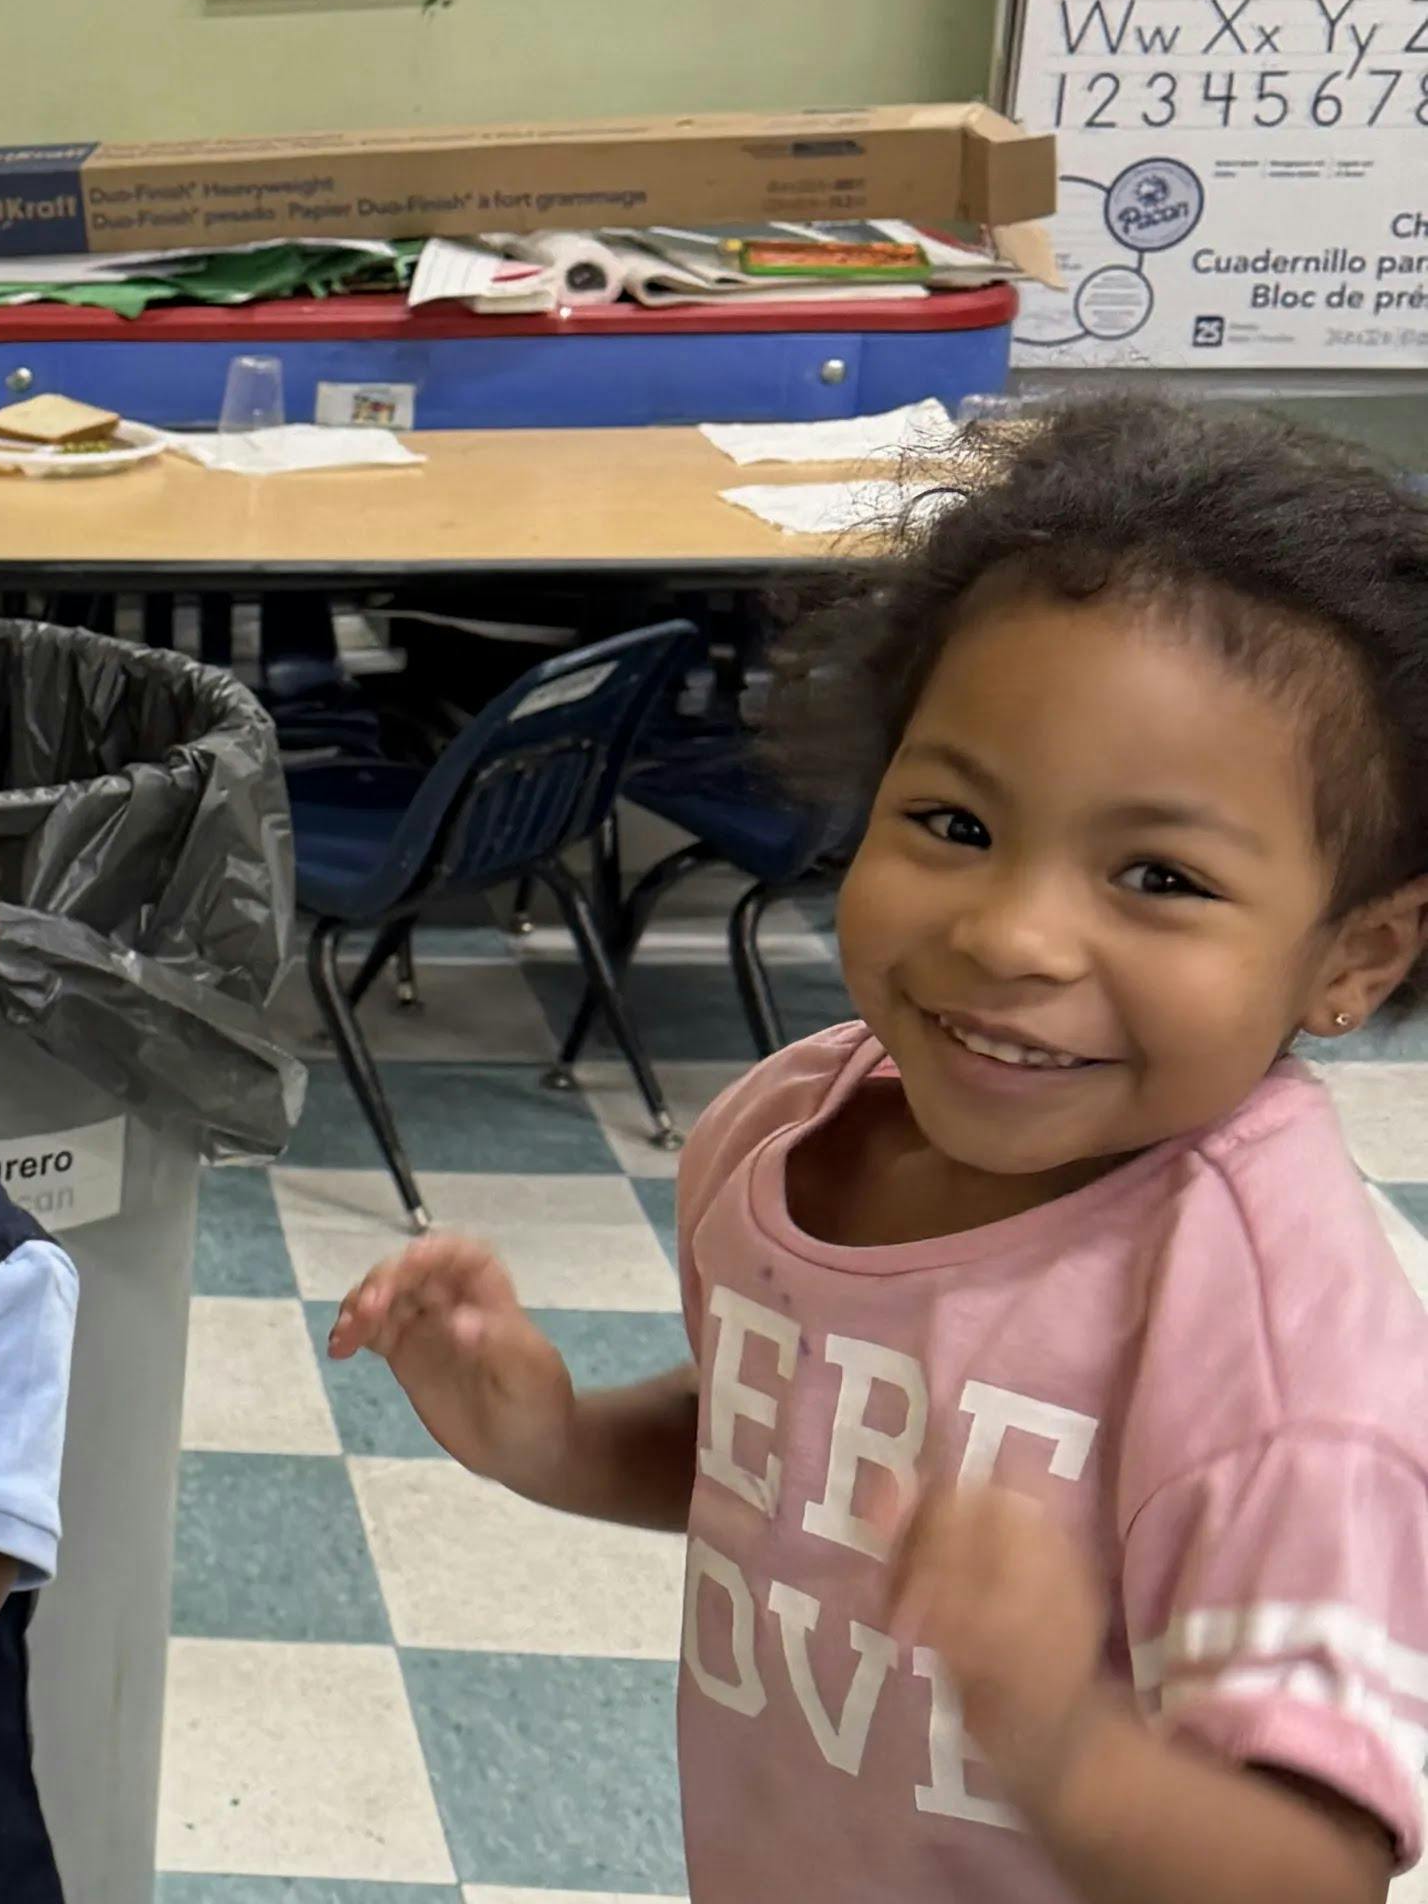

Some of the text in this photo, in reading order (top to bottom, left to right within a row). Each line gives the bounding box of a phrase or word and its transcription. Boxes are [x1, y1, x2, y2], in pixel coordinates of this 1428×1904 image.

[1117, 202, 1189, 234] Pacon
[1391, 213, 1428, 239] Ch
[1192, 248, 1428, 280] Cuadernillo par
[1251, 283, 1316, 309] Bloc
[1325, 283, 1364, 309] de
[1195, 320, 1223, 345] 25
